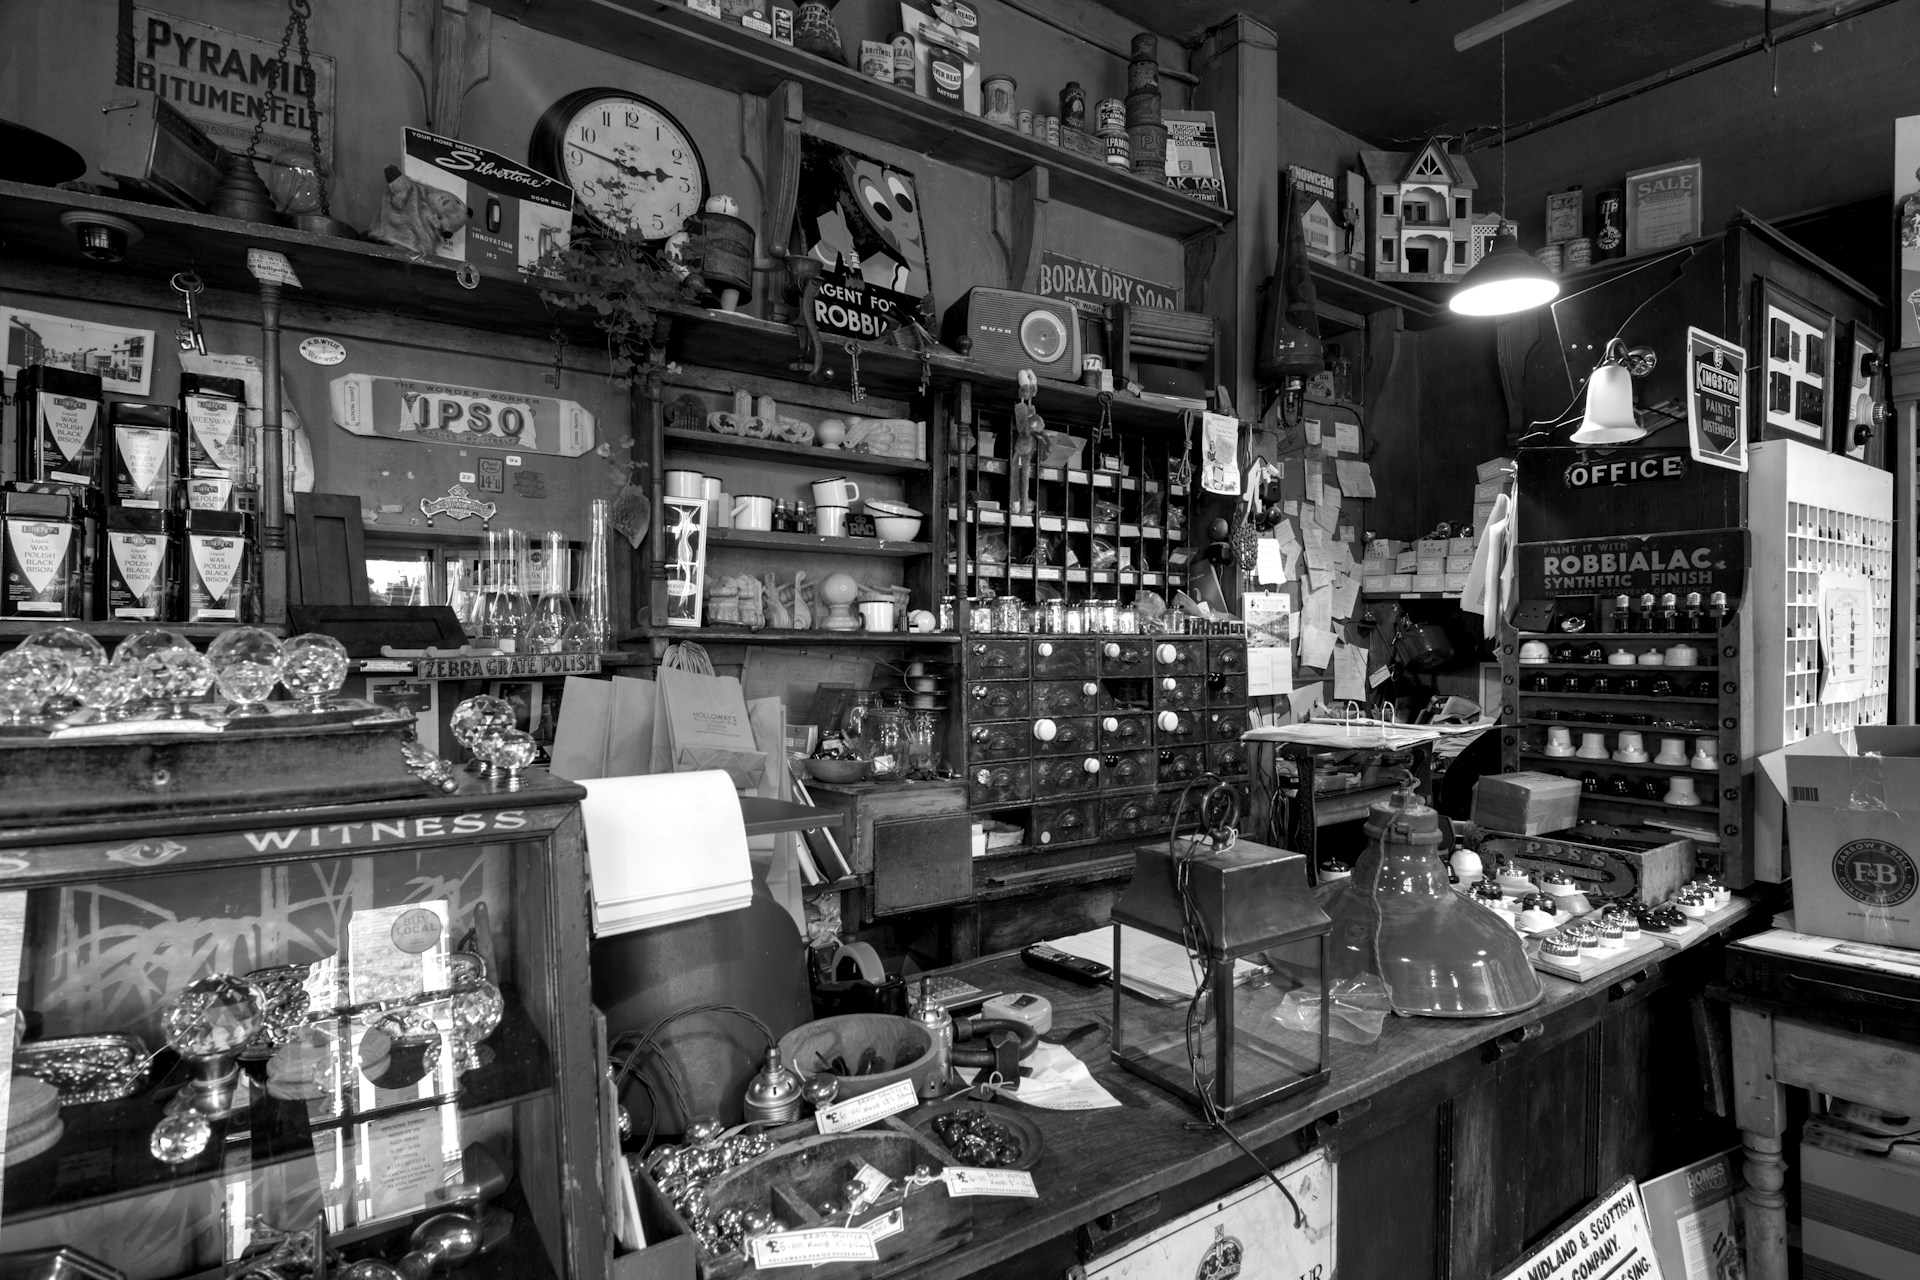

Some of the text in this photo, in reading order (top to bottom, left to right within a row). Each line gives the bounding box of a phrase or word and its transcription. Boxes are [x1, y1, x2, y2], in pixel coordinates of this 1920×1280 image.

[957, 10, 976, 22] READY
[146, 17, 318, 98] PYRAMID
[136, 61, 325, 132] BITUMEN FELT
[936, 87, 960, 100] BATTERY
[603, 111, 611, 127] 11
[625, 111, 640, 130] 12
[581, 126, 596, 144] 10
[656, 126, 660, 141] 1
[411, 131, 431, 142] YOUR
[433, 137, 453, 148] HOME
[455, 144, 477, 155] NEEDS
[571, 150, 584, 166] 9
[672, 149, 682, 165] 2
[435, 150, 541, 188] Silvertone
[582, 180, 596, 198] 8
[679, 176, 690, 193] 3
[1192, 178, 1222, 192] TAR
[1638, 175, 1692, 199] SALE
[530, 194, 567, 208] DOOR BELL
[670, 202, 680, 217] 4
[652, 214, 664, 230] 5
[472, 232, 513, 250] INNOVATION
[1040, 264, 1099, 296] BORAX
[1102, 271, 1133, 303] DRY
[1082, 302, 1101, 312] WASH
[1084, 359, 1102, 370] IZA
[1696, 361, 1739, 397] KINGSTON
[394, 381, 541, 405] THE WONDER WORKER
[417, 396, 526, 436] IPSO
[1705, 398, 1732, 418] PAINTS
[56, 422, 83, 431] POLISH
[61, 416, 78, 424] WAX
[193, 416, 233, 426] BEESWAX
[1702, 418, 1735, 440] DISTEMPERS
[57, 430, 82, 438] BLACK
[58, 436, 81, 444] BISON
[1571, 456, 1681, 486] OFFICE
[850, 523, 874, 536] RAC
[24, 551, 56, 559] POLISH
[1543, 542, 1628, 555] PAINT IT WITH
[1544, 547, 1712, 576] ROBBIALAC
[1544, 571, 1712, 589] SYNTHETIC FINISH
[1600, 588, 1647, 596] DISCOVERY
[1653, 586, 1666, 594] OF
[1671, 585, 1712, 594] SCIENCE
[425, 658, 484, 679] ZEBRA
[486, 656, 538, 676] GRATE
[542, 654, 597, 673] POLISH
[244, 810, 528, 852] WITNESS
[1837, 842, 1912, 872] FARROW & BALL
[1852, 861, 1898, 885] F&B
[1840, 877, 1870, 902] DORSET
[396, 923, 438, 936] LOCAL
[403, 915, 429, 926] BUY
[1687, 1162, 1725, 1190] HOMES
[1527, 1192, 1636, 1280] MIDLAND & SCOTTISH
